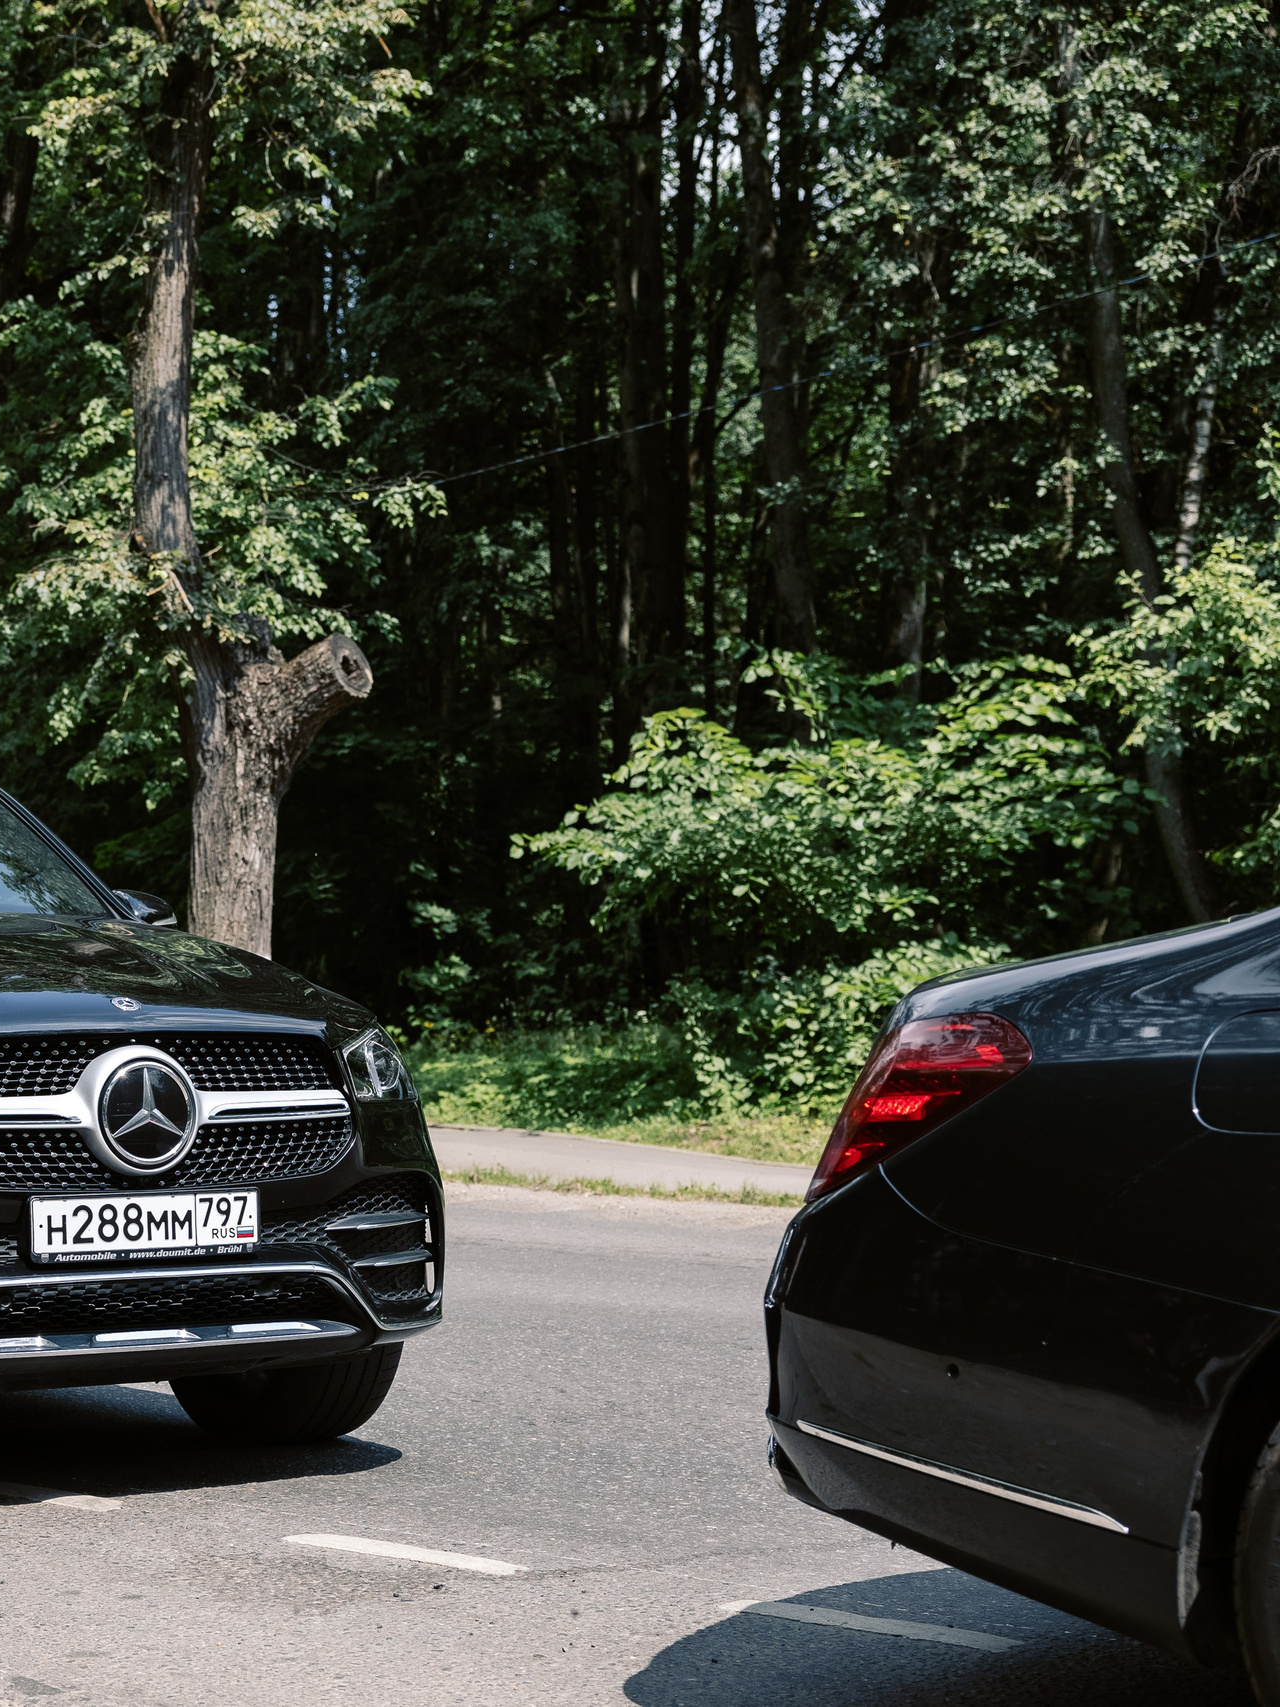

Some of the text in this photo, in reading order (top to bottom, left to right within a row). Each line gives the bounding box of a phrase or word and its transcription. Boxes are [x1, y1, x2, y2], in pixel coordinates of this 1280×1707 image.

[199, 1196, 249, 1228] 797
[212, 1228, 236, 1239] RUS
[54, 1244, 243, 1262] Automobile www.doumit.de Brühl
